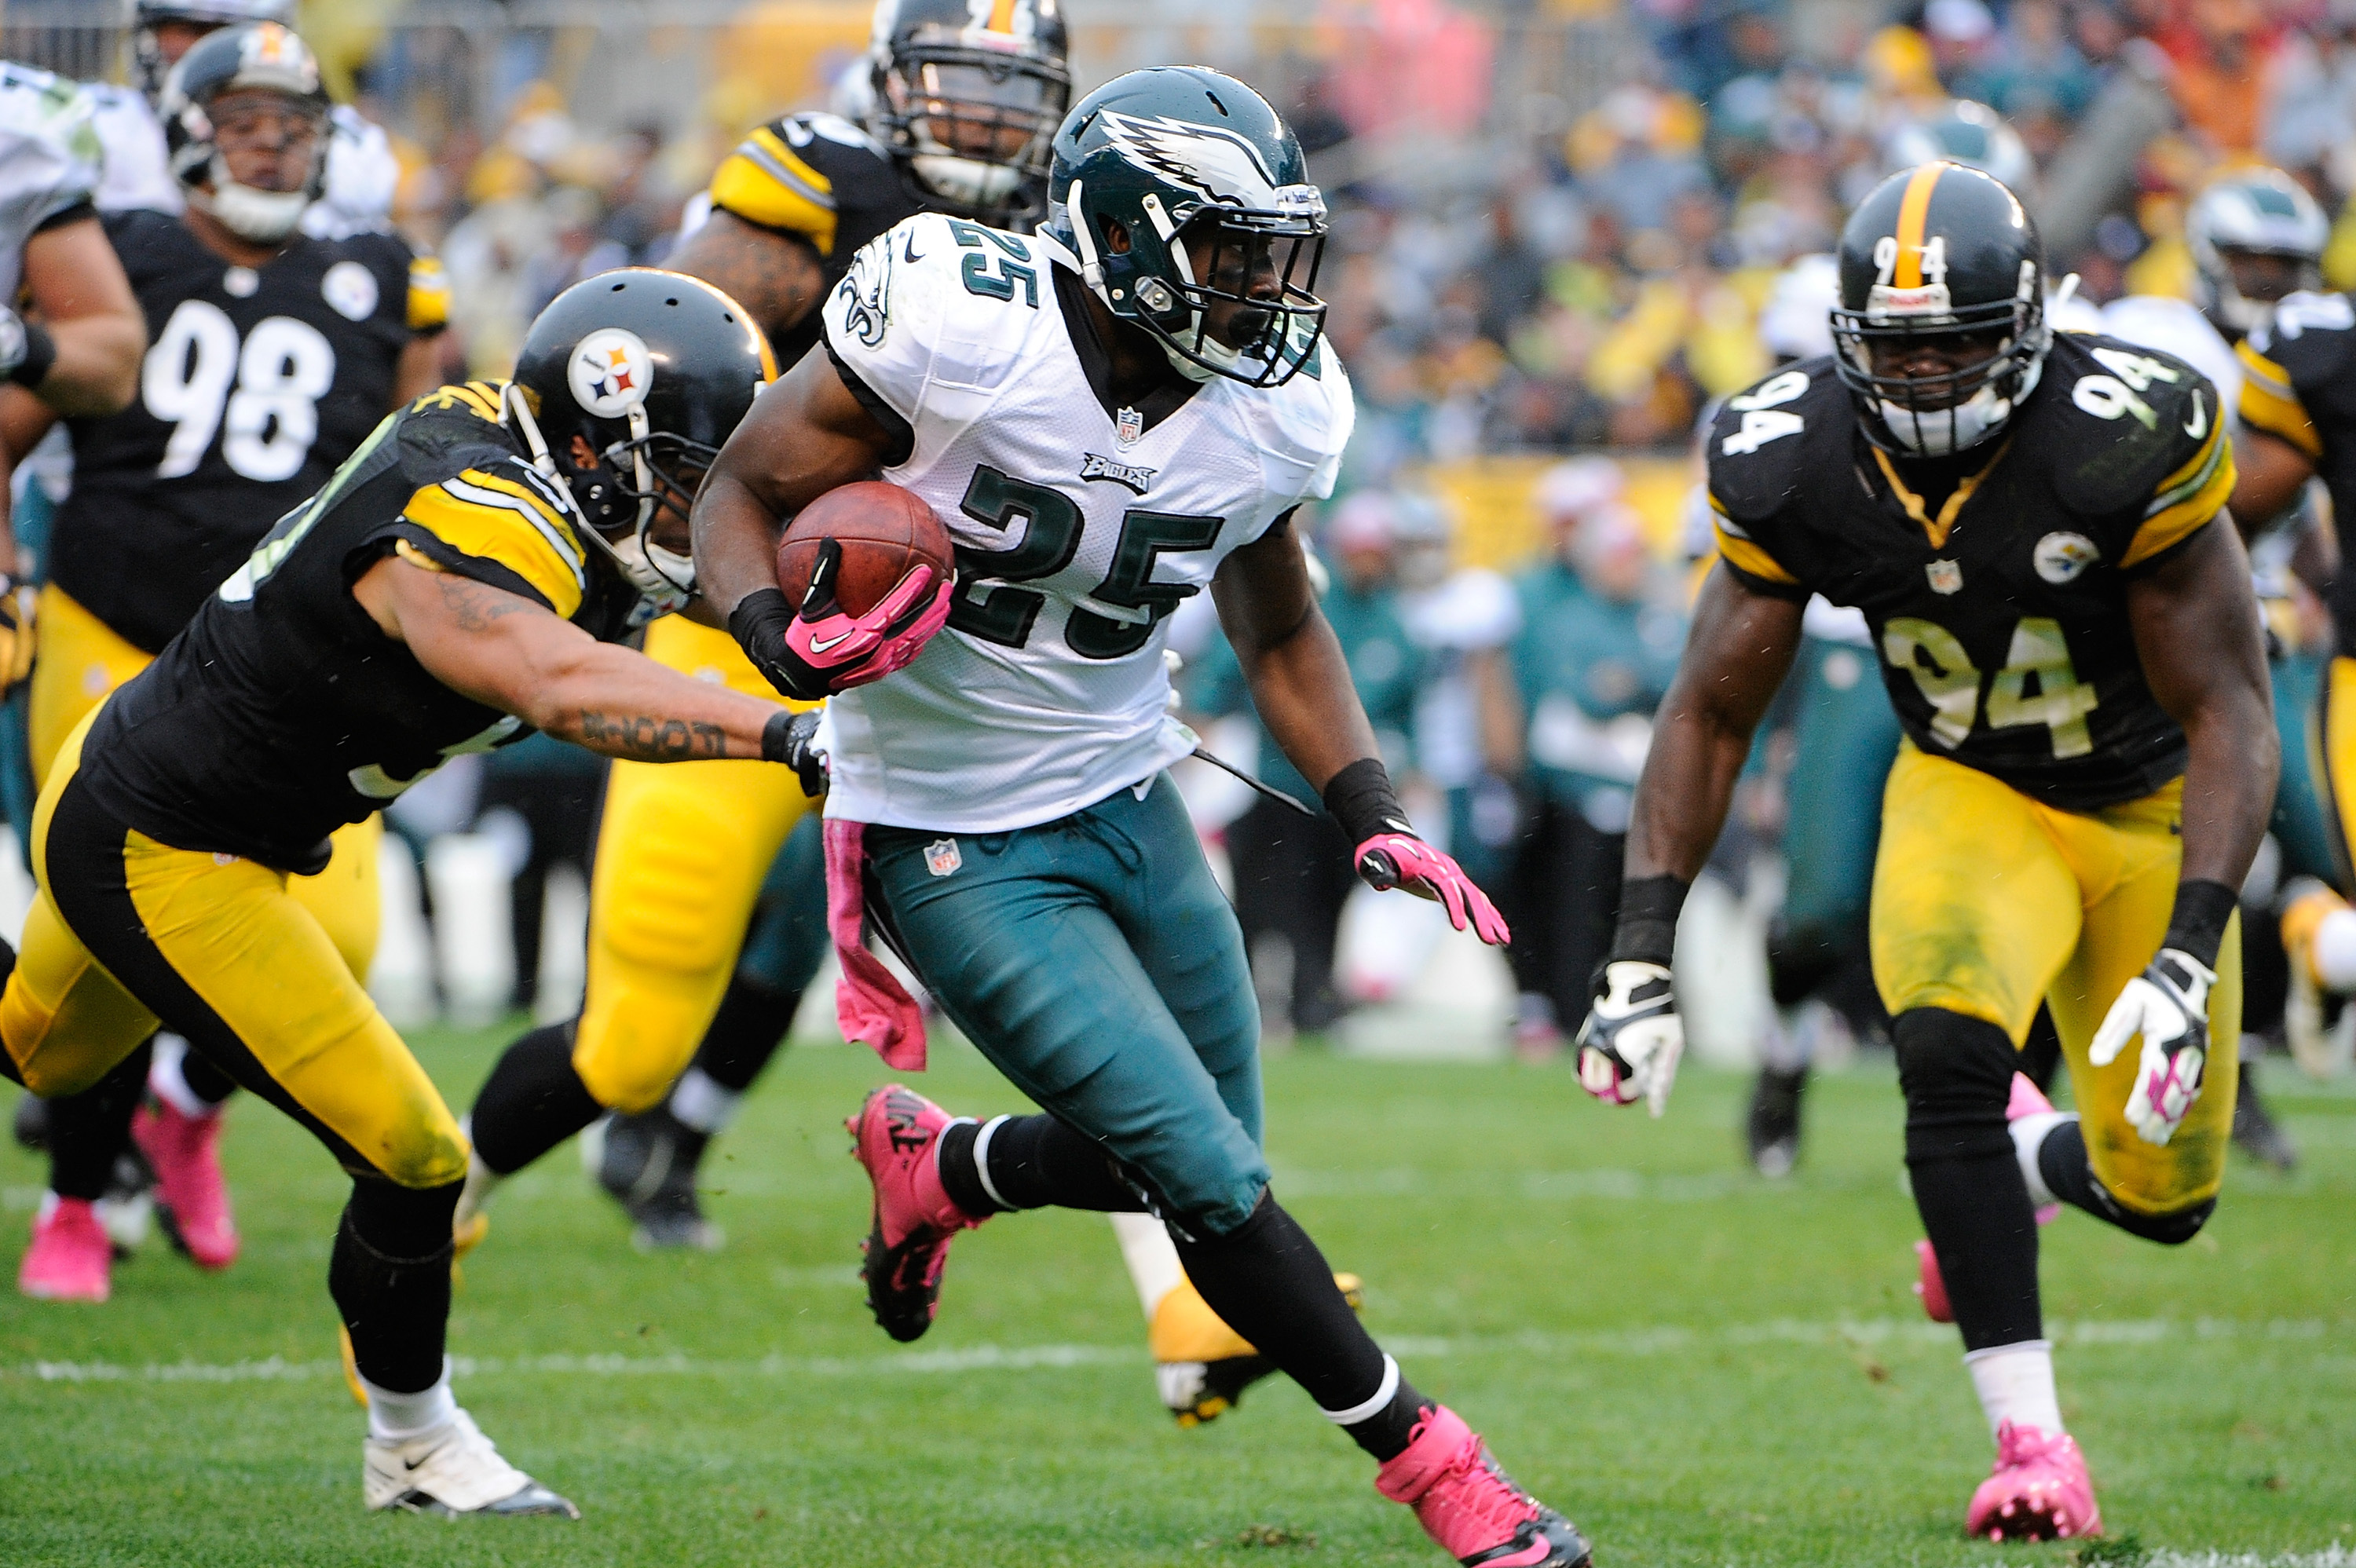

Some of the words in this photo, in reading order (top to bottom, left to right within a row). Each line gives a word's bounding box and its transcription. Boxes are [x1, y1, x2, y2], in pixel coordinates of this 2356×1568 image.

[945, 218, 1039, 309] 25
[1874, 236, 1948, 286] 94
[141, 298, 336, 482] 98
[1722, 371, 1810, 456] 94
[2070, 347, 2181, 430] 94
[1080, 452, 1158, 496] EAGLES
[946, 462, 1226, 660] 25
[1882, 616, 2098, 760] 94
